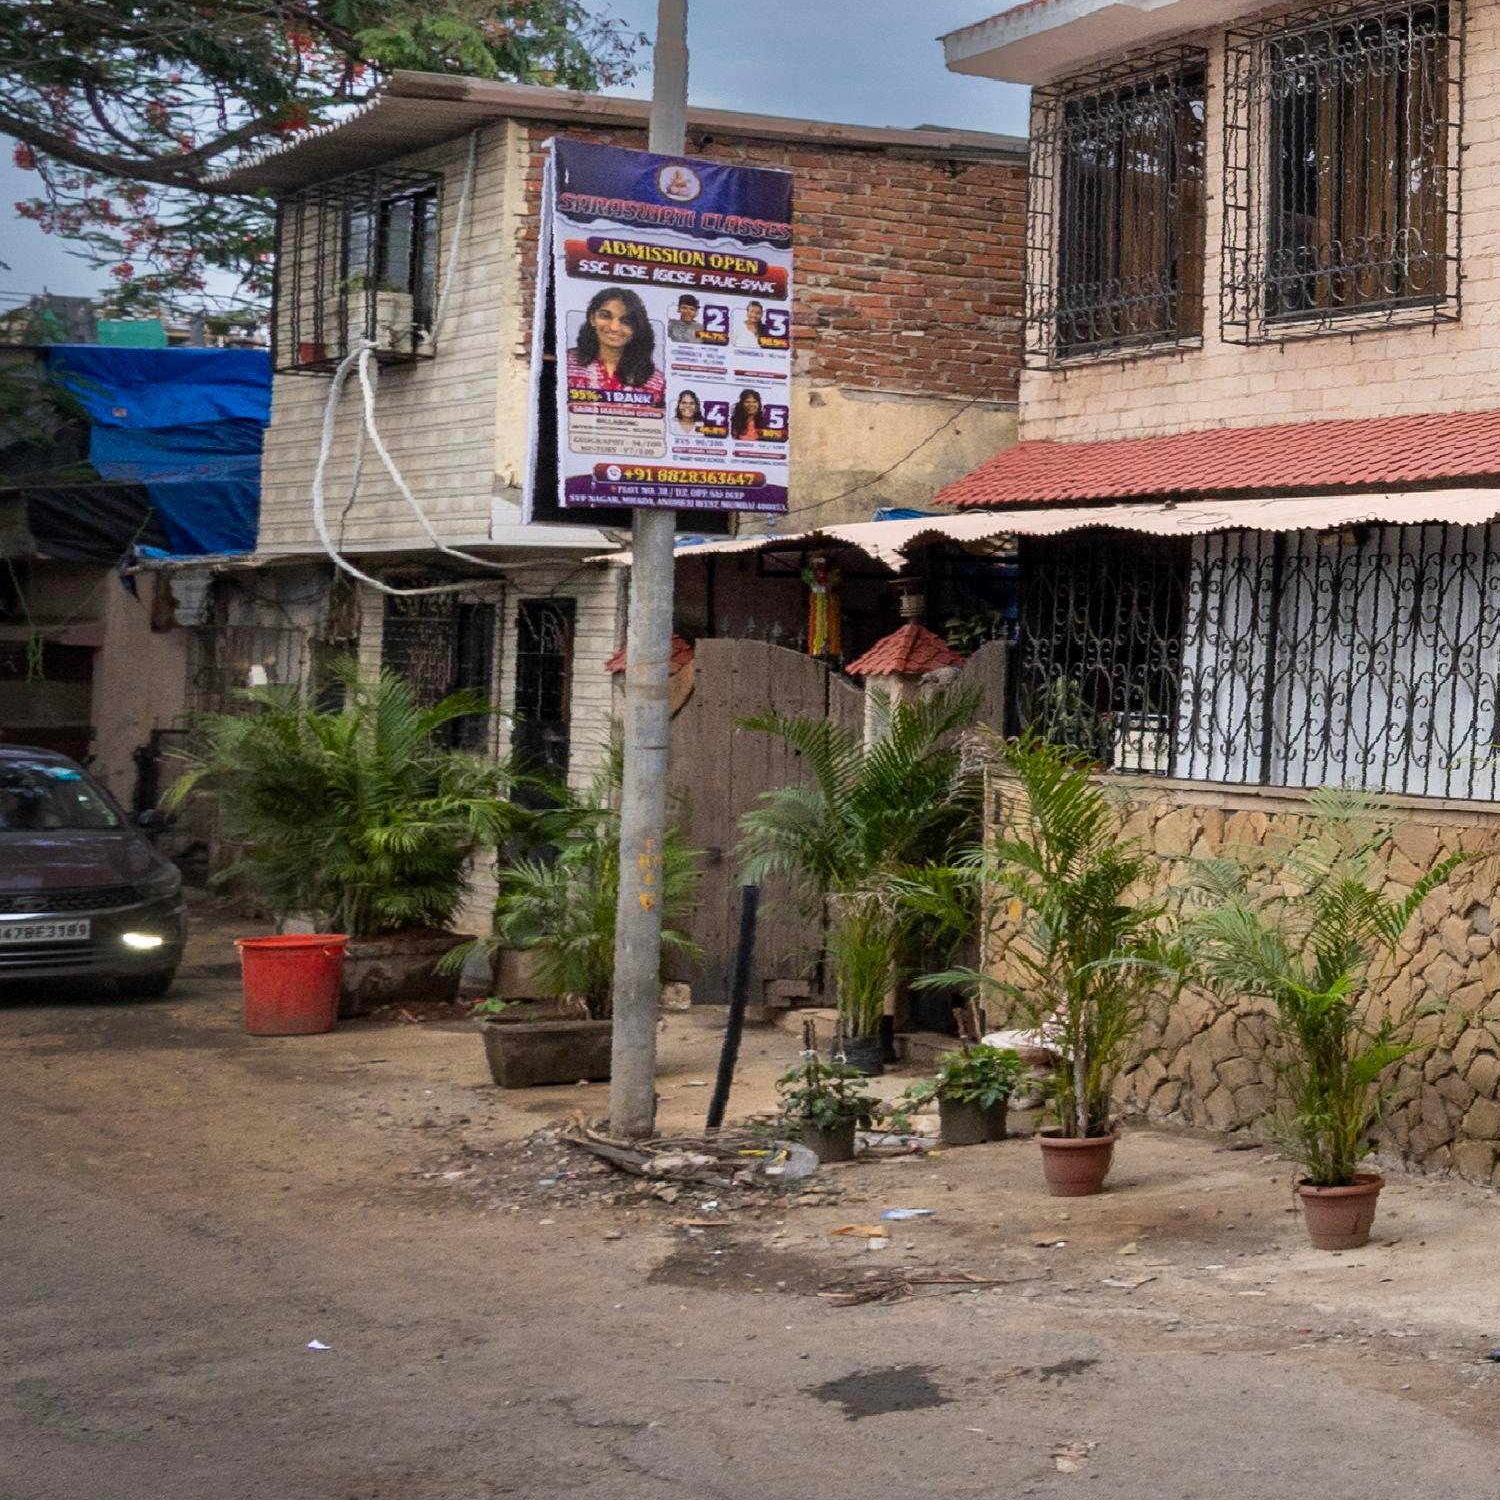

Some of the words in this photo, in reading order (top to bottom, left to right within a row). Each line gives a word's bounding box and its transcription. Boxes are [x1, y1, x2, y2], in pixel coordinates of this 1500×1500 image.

[558, 192, 696, 229] SARASWATI
[701, 212, 792, 240] CLASSES
[599, 240, 705, 267] ADMISSION
[709, 253, 759, 275] OPEN
[613, 392, 652, 404] RANK
[624, 467, 654, 482] +91
